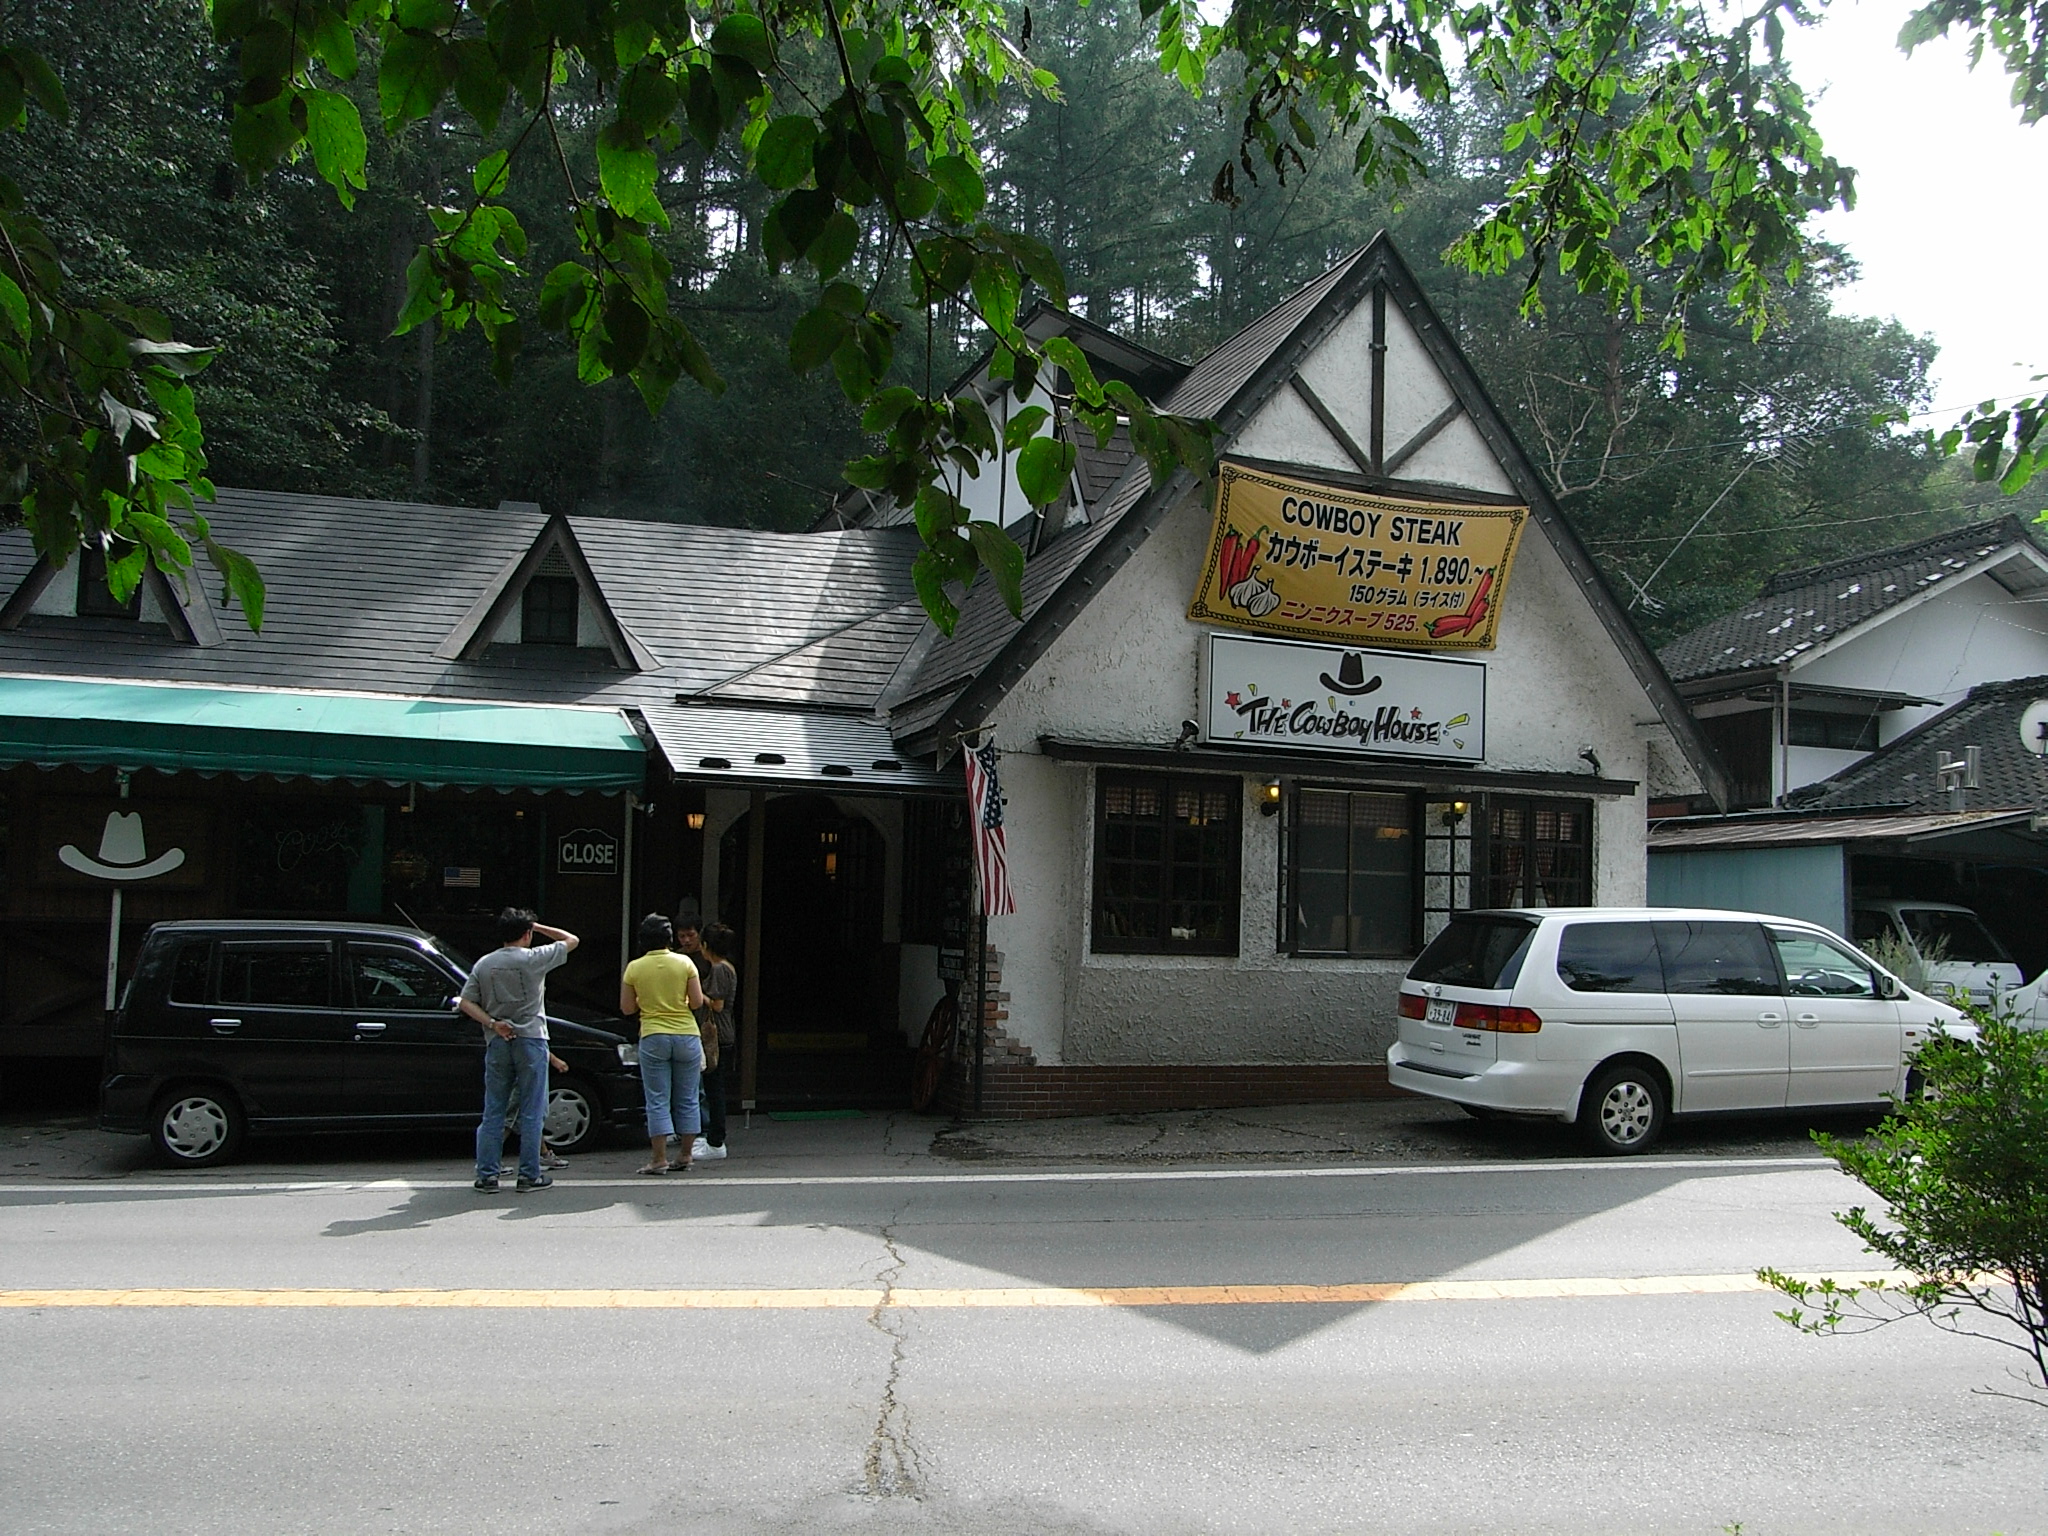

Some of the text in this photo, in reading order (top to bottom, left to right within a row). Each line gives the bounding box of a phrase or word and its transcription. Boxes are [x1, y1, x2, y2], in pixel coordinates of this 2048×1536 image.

[1281, 496, 1464, 547] COWBOY STEAK
[1266, 532, 1413, 584] カウボーイステーキ
[1236, 697, 1288, 736] THE
[562, 842, 614, 864] CLOSE
